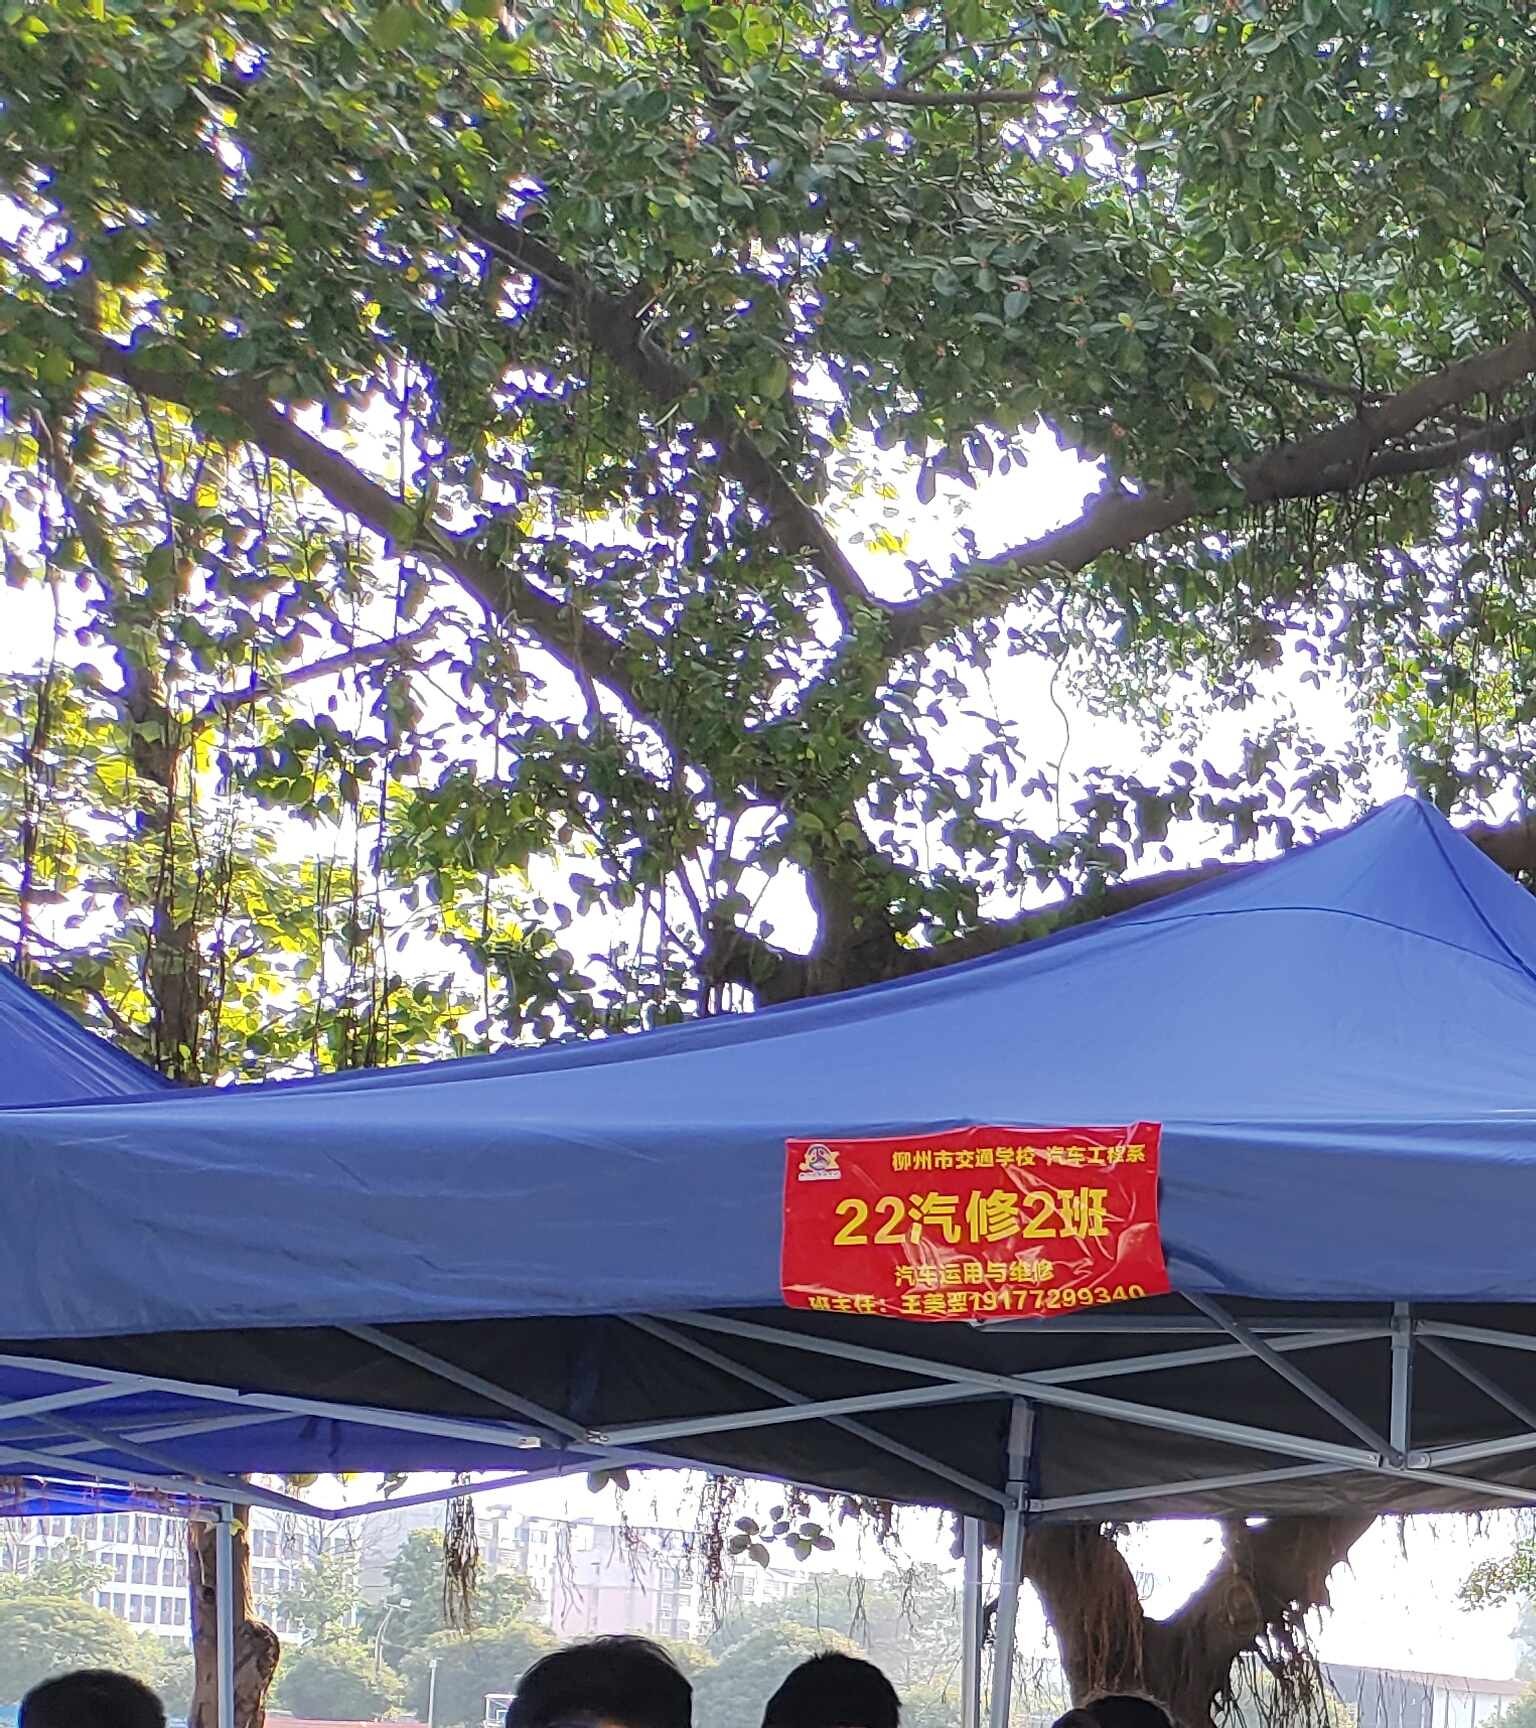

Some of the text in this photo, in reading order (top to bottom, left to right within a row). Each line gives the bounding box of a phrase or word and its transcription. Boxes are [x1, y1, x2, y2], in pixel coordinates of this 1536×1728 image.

[891, 1143, 1147, 1172] 柳州市交通学校 汽车工程系
[833, 1186, 1109, 1246] 22汽修2班
[895, 1258, 1055, 1287] 汽车运用与维修
